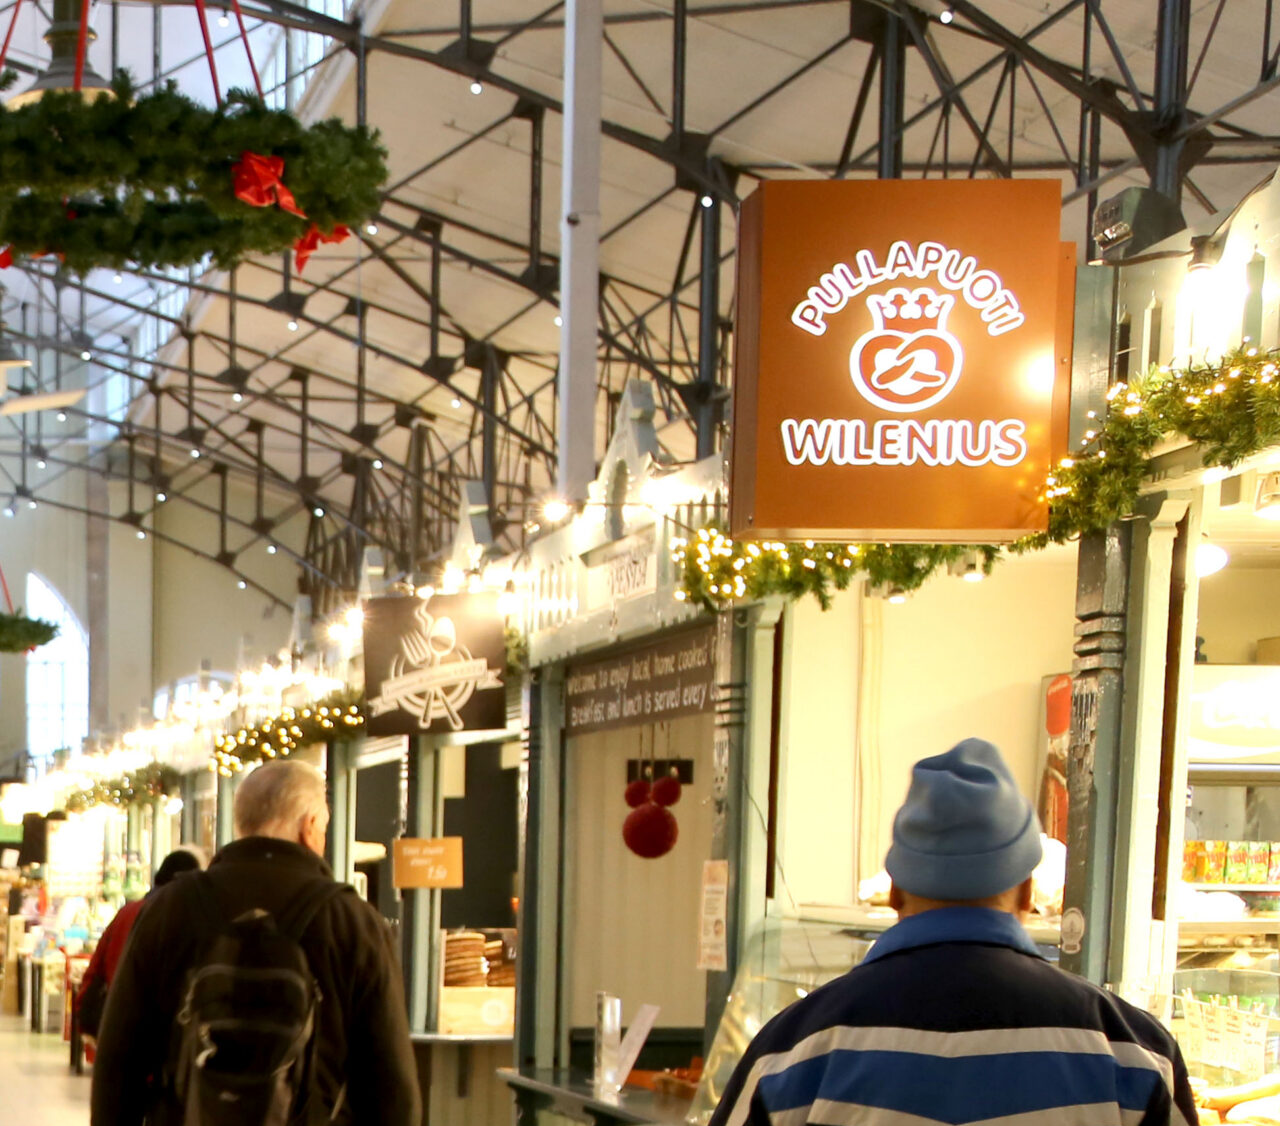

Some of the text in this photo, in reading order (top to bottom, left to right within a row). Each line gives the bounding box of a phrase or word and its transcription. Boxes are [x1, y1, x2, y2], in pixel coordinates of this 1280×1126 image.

[791, 240, 1026, 337] PULLAPUOTI
[780, 417, 1028, 468] WILENIUS
[678, 639, 708, 672] cooked
[654, 678, 681, 713] served
[683, 683, 708, 710] every
